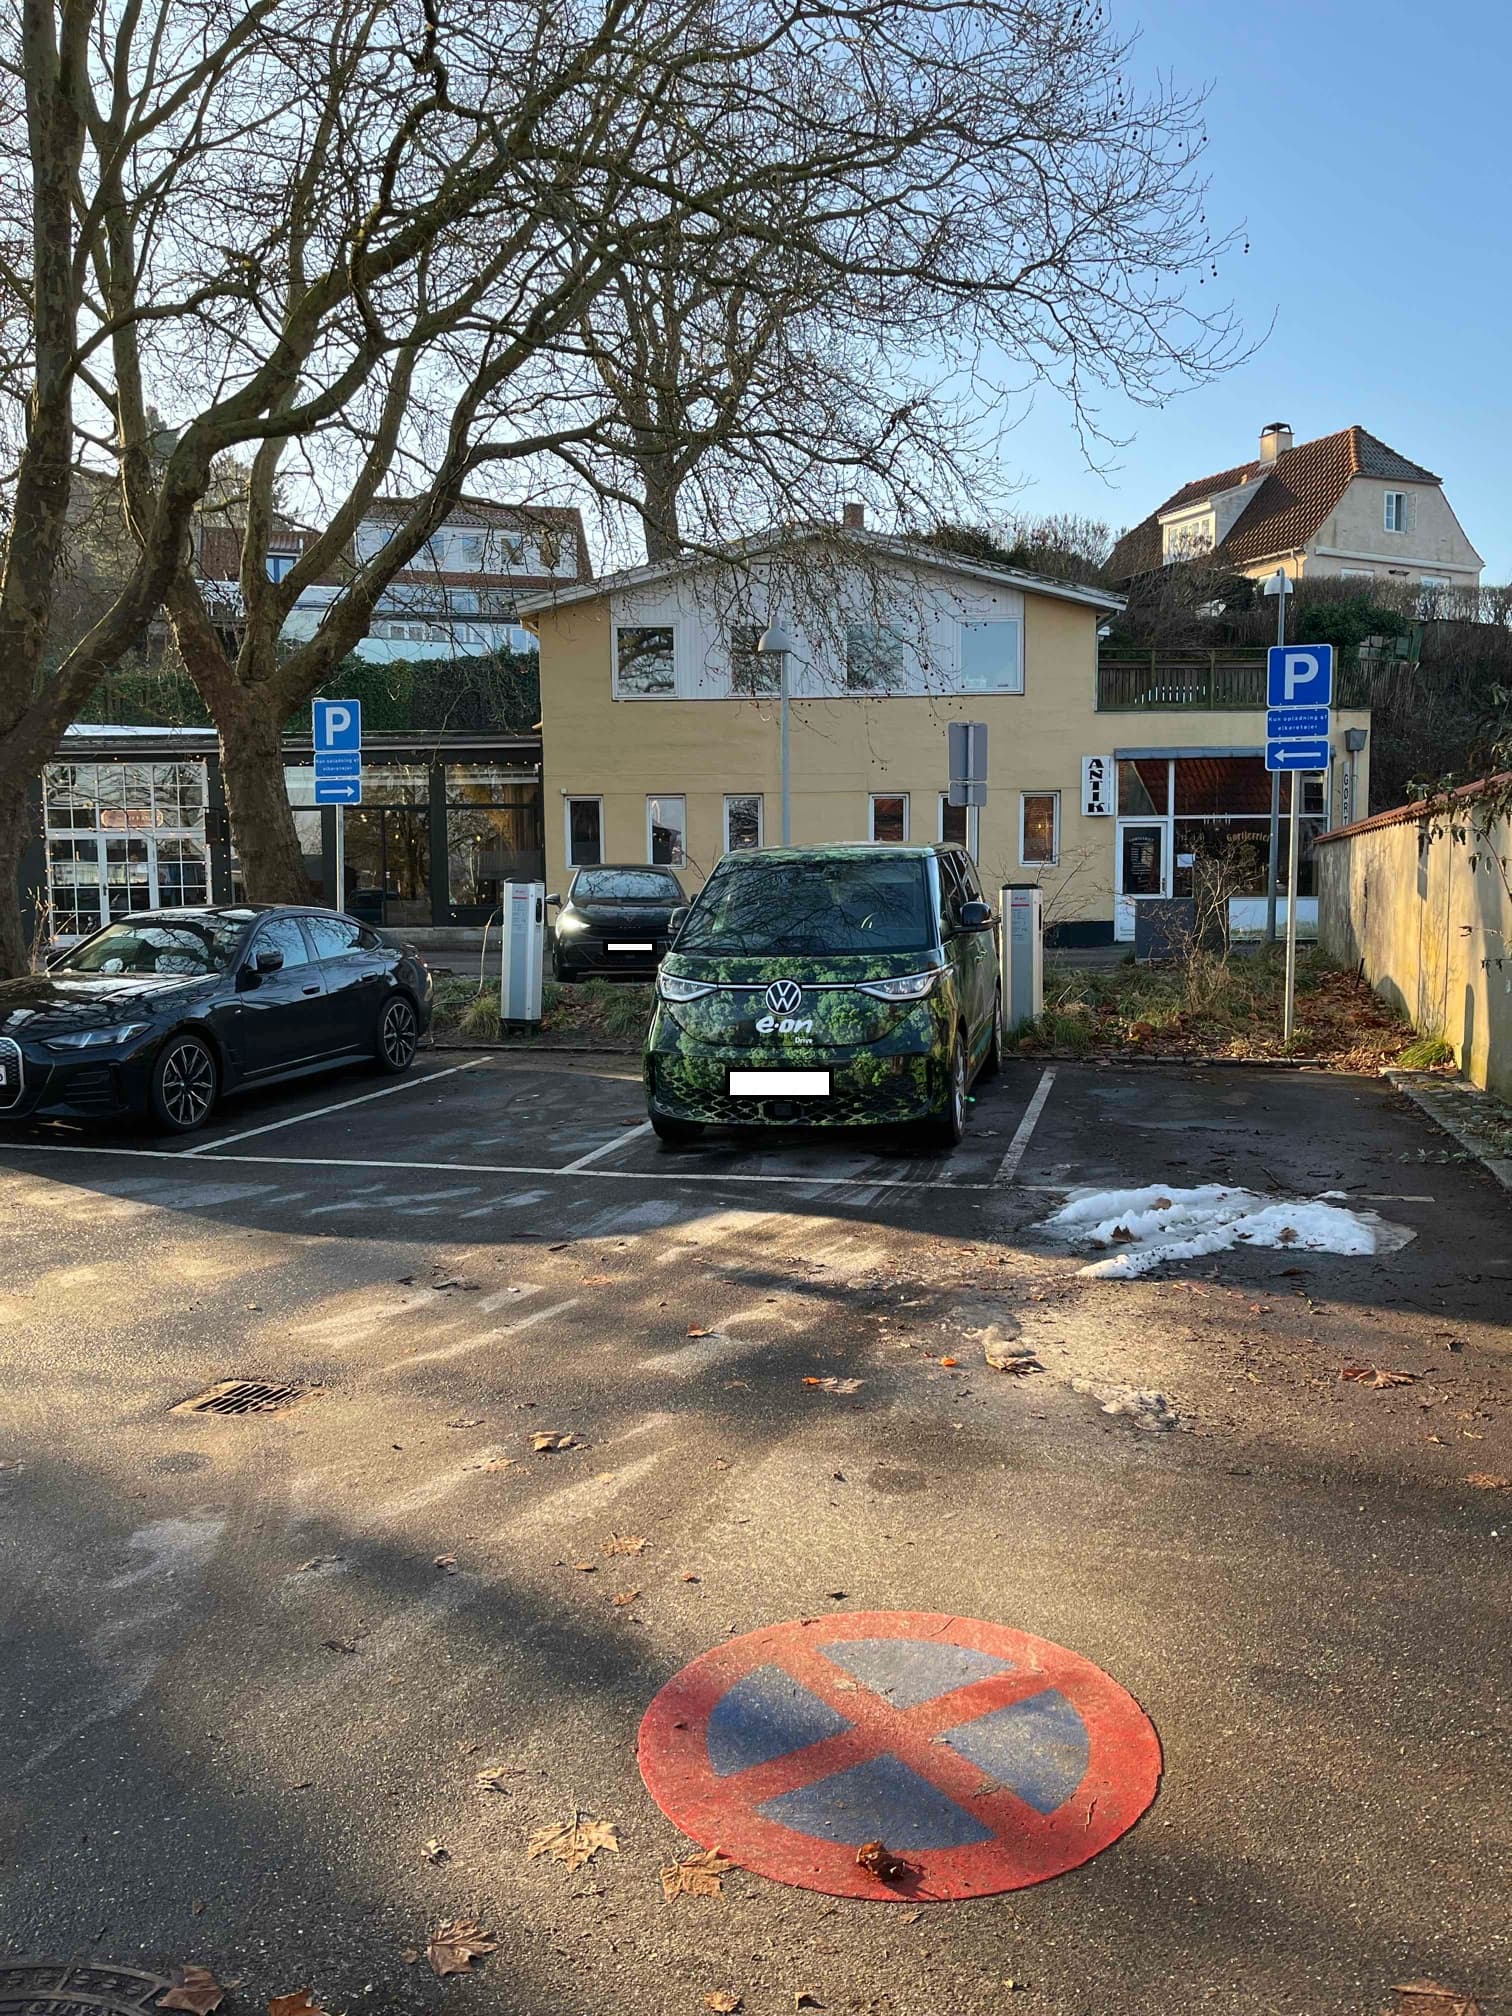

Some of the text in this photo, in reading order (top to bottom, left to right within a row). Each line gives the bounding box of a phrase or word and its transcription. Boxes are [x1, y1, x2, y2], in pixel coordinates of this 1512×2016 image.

[1284, 653, 1319, 700] P
[326, 707, 351, 746] P
[1087, 758, 1105, 813] ANTIK
